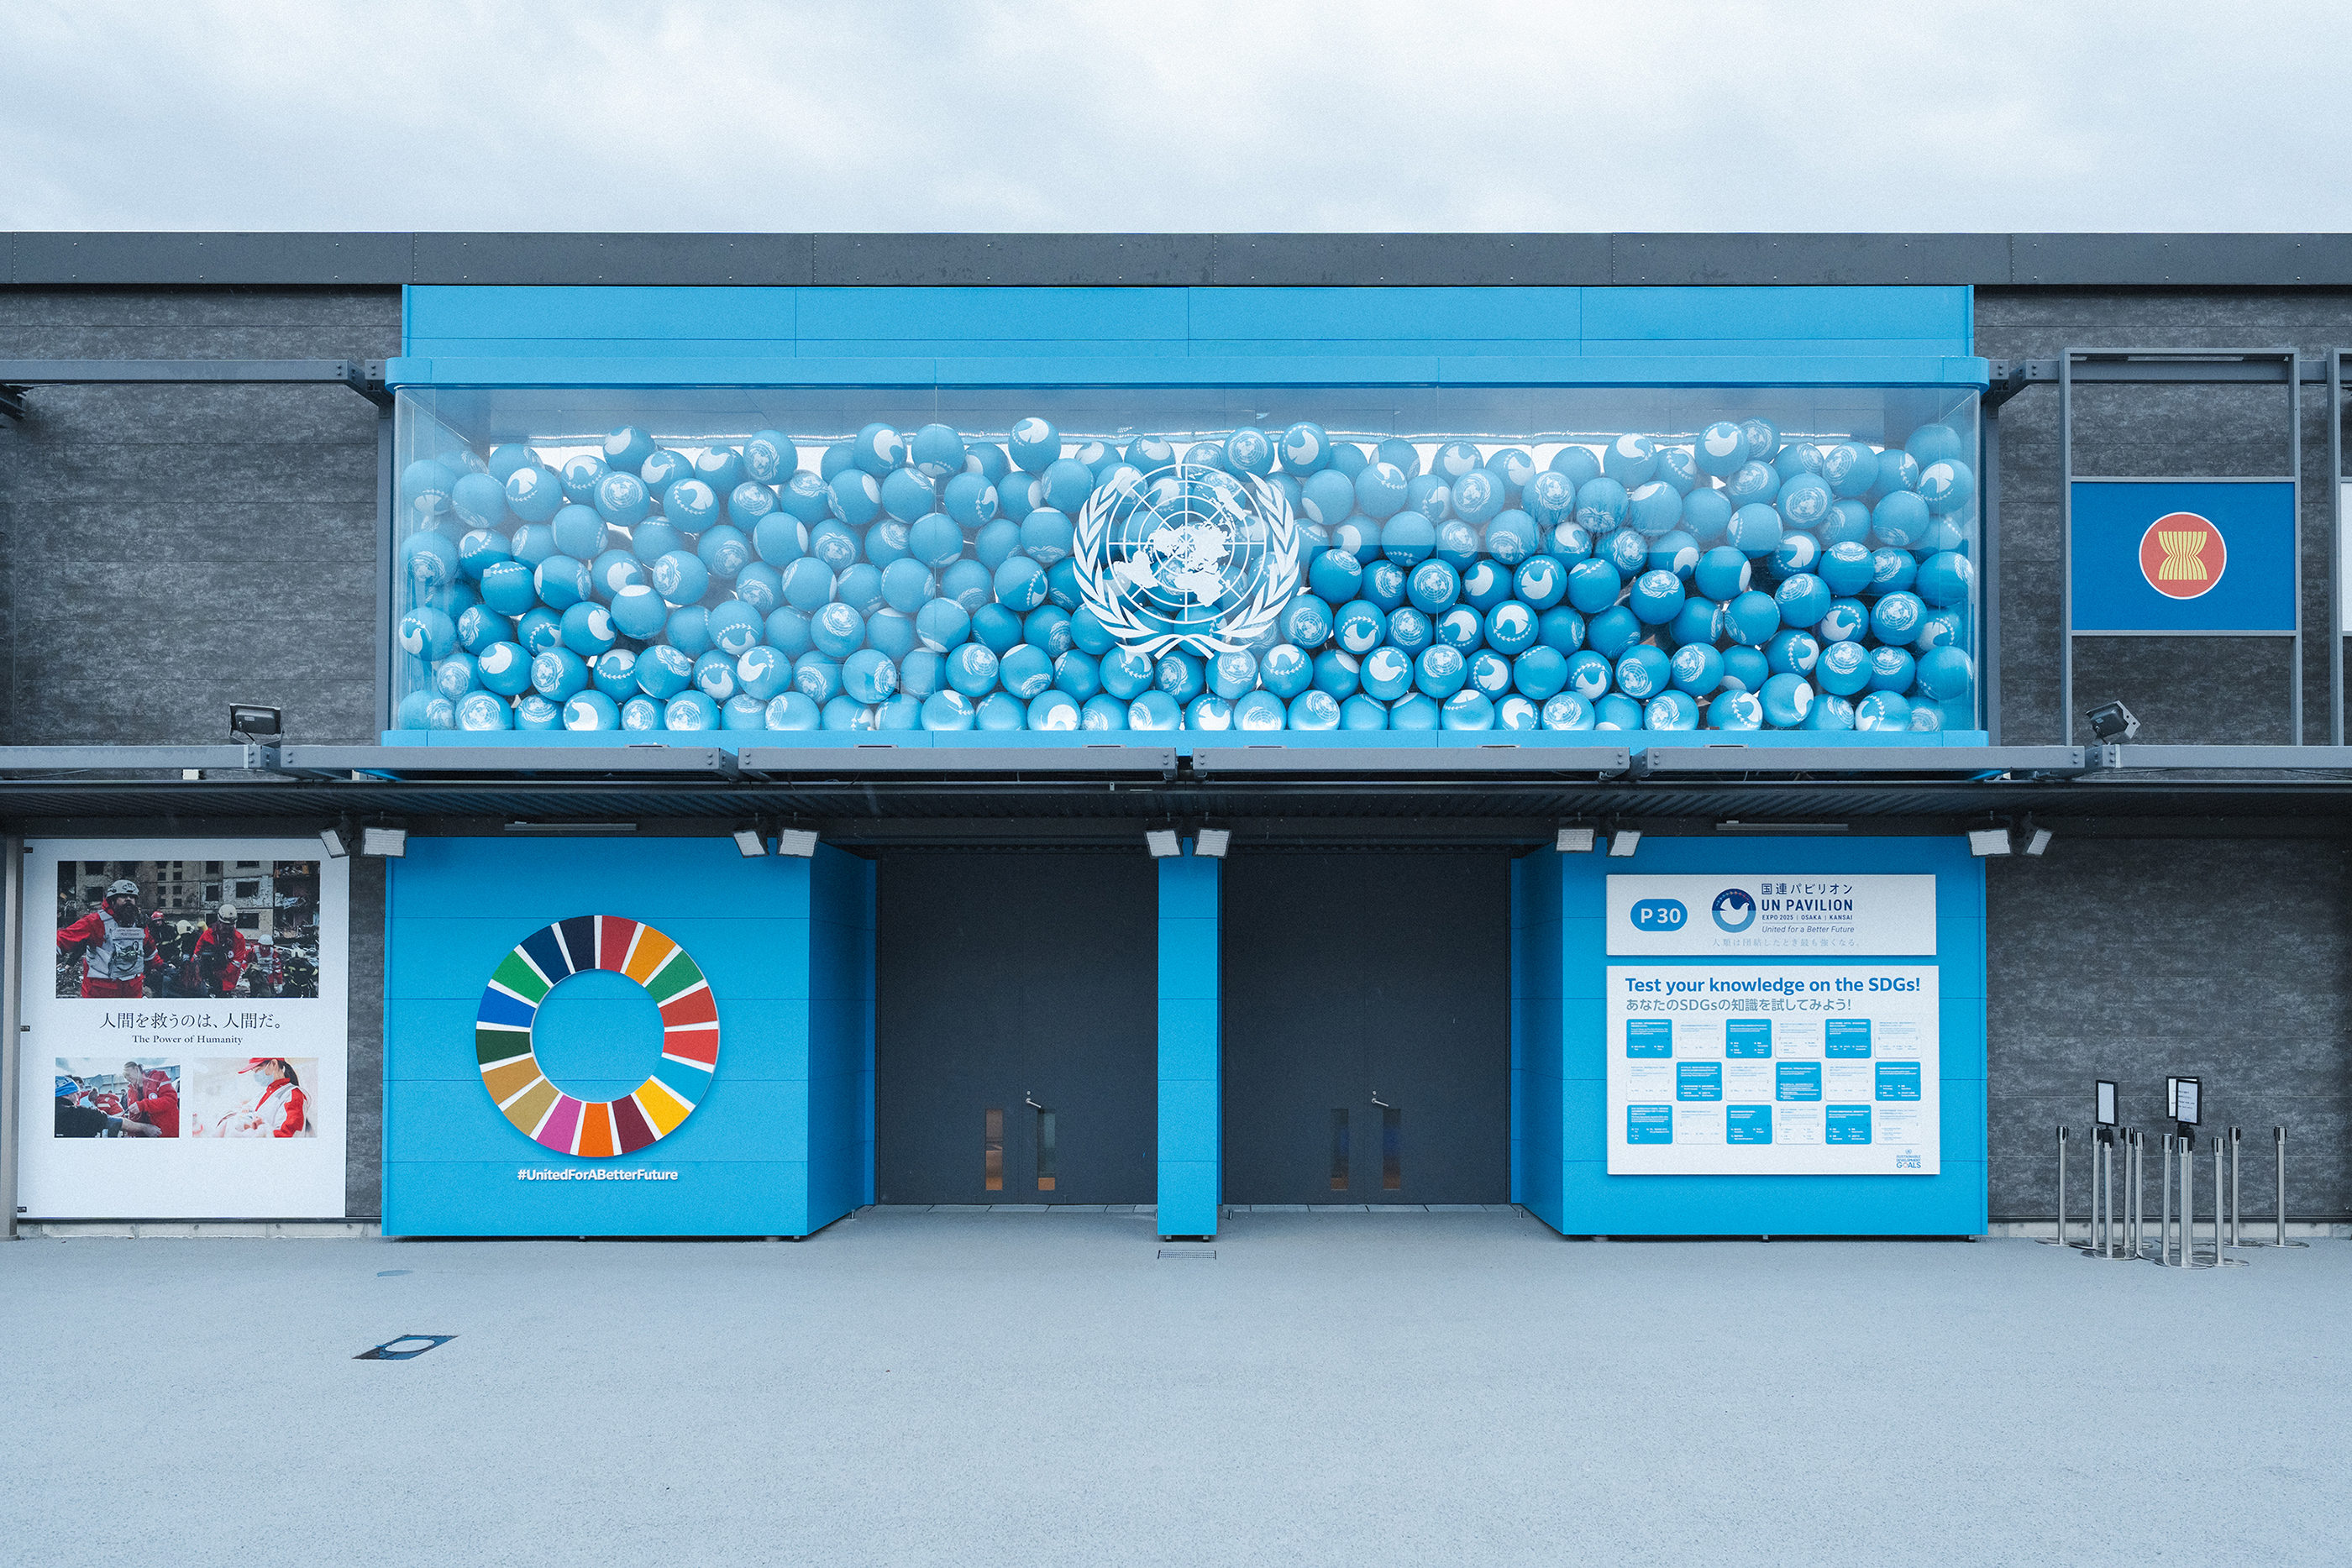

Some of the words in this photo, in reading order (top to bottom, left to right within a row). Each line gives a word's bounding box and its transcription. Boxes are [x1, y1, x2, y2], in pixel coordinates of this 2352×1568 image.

[1761, 883, 1852, 894] 国連パビリオン
[1761, 899, 1780, 911] UN
[1786, 899, 1852, 911] PAVILION
[1641, 908, 1653, 923] P
[1657, 908, 1681, 924] 30
[1625, 978, 1662, 992] Test
[1665, 981, 1704, 996] your
[1709, 978, 1804, 996] knowledge
[1809, 981, 1830, 992] on
[1835, 978, 1863, 992] the
[1868, 977, 1920, 992] SDGs!
[99, 1012, 281, 1029] 人間を救うのは、人間だ。
[132, 1035, 150, 1043] The
[153, 1035, 181, 1043] Power
[184, 1035, 195, 1043] of
[197, 1035, 243, 1046] Humanity
[517, 1169, 679, 1181] #UnitedForABetterFuture
